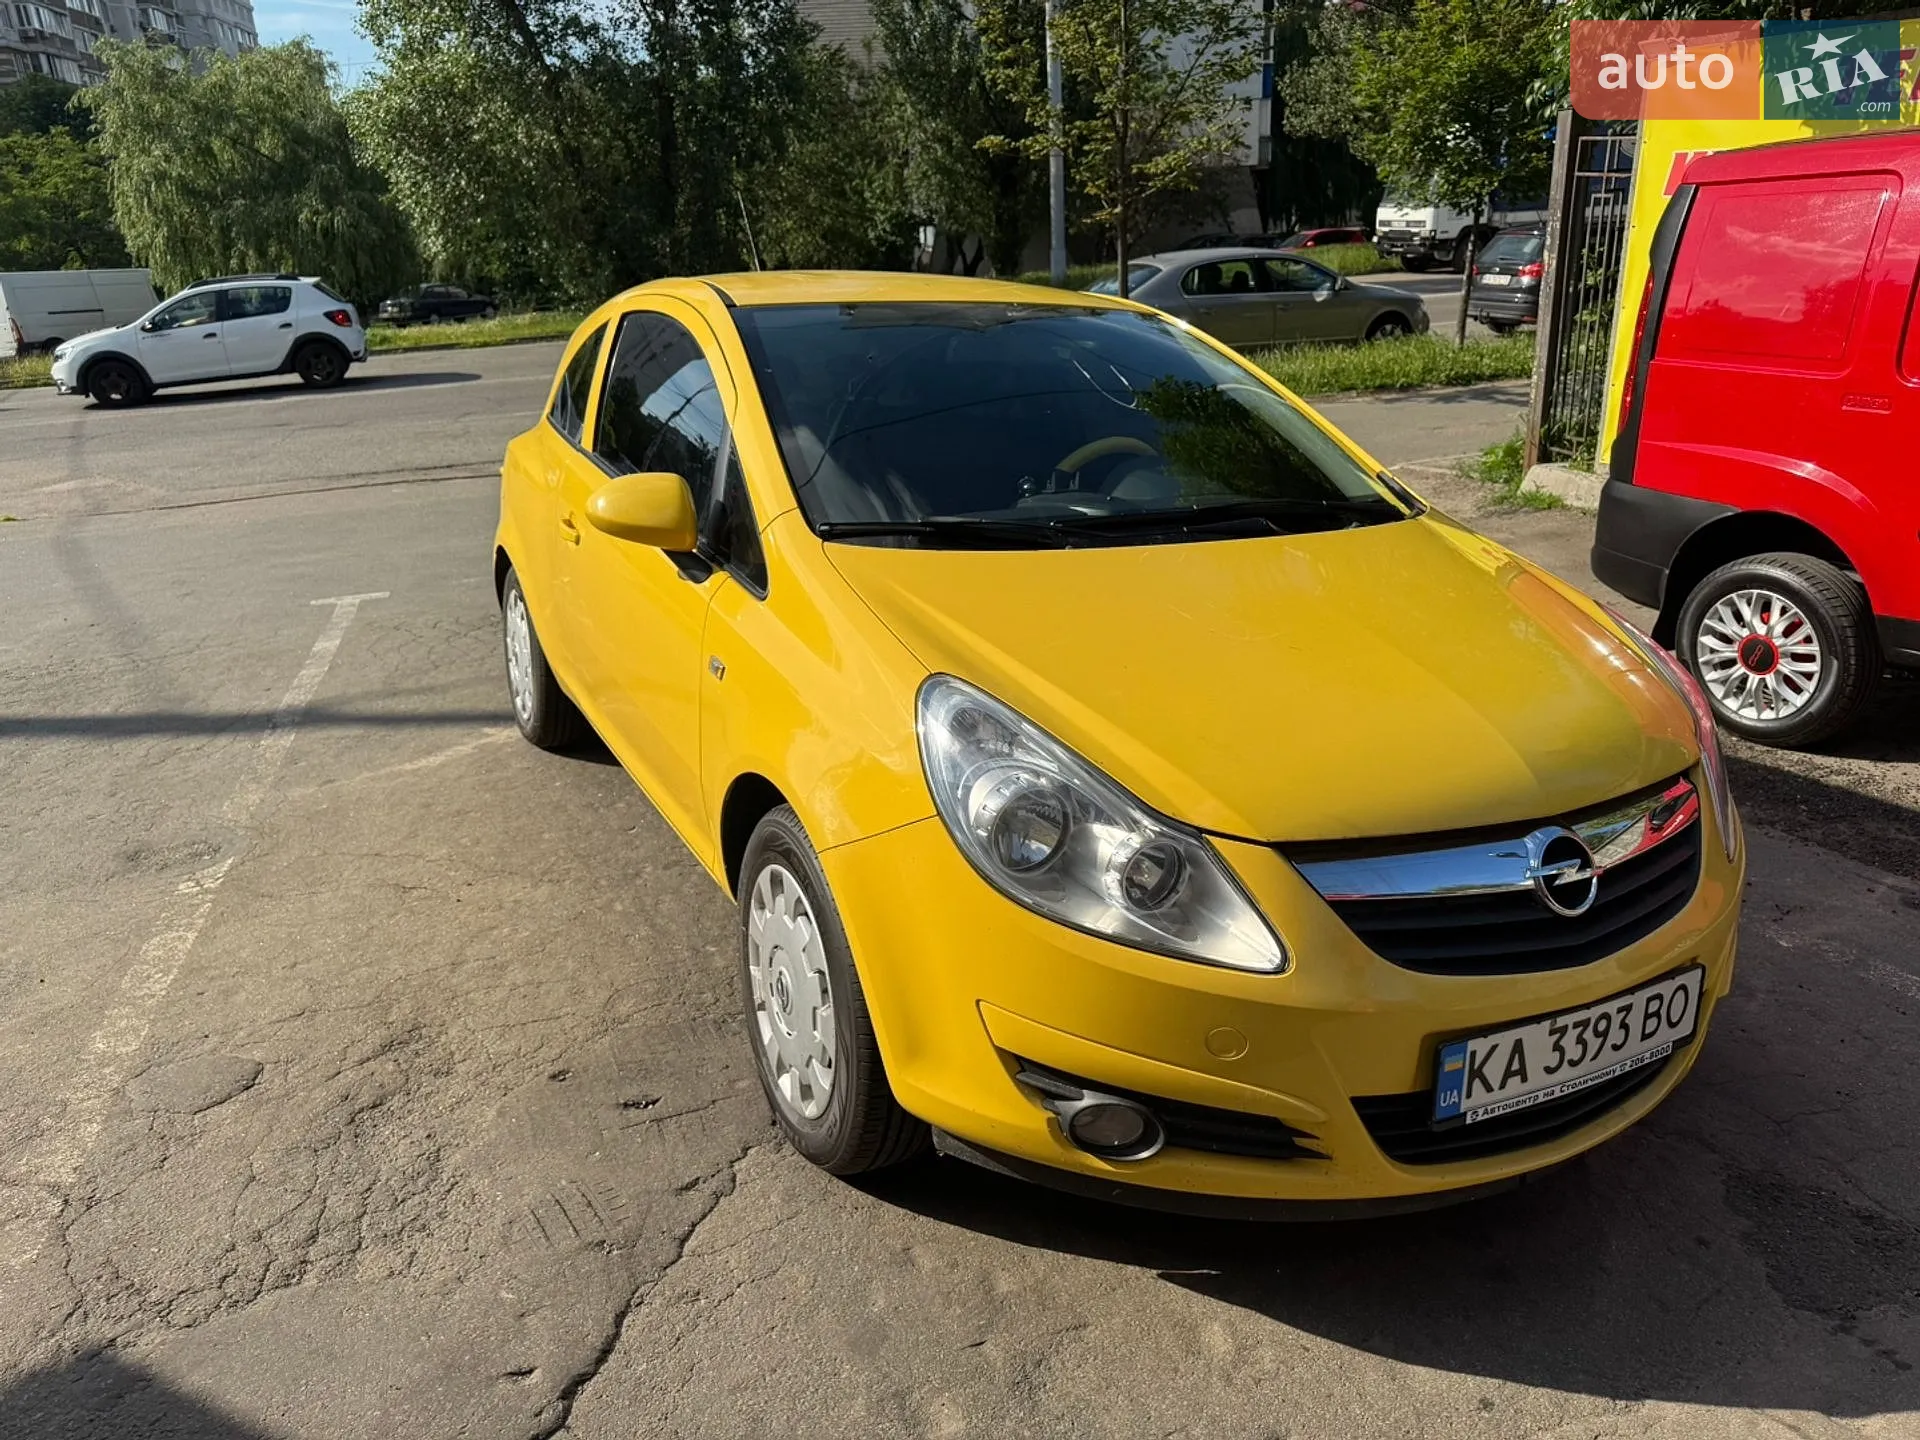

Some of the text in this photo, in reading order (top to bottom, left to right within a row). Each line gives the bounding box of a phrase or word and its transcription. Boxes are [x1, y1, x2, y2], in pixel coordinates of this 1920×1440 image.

[1466, 983, 1689, 1099] KA 3393 BO
[1440, 1089, 1459, 1107] UA
[1481, 1093, 1540, 1117] Автоцентр
[1543, 1088, 1555, 1099] на
